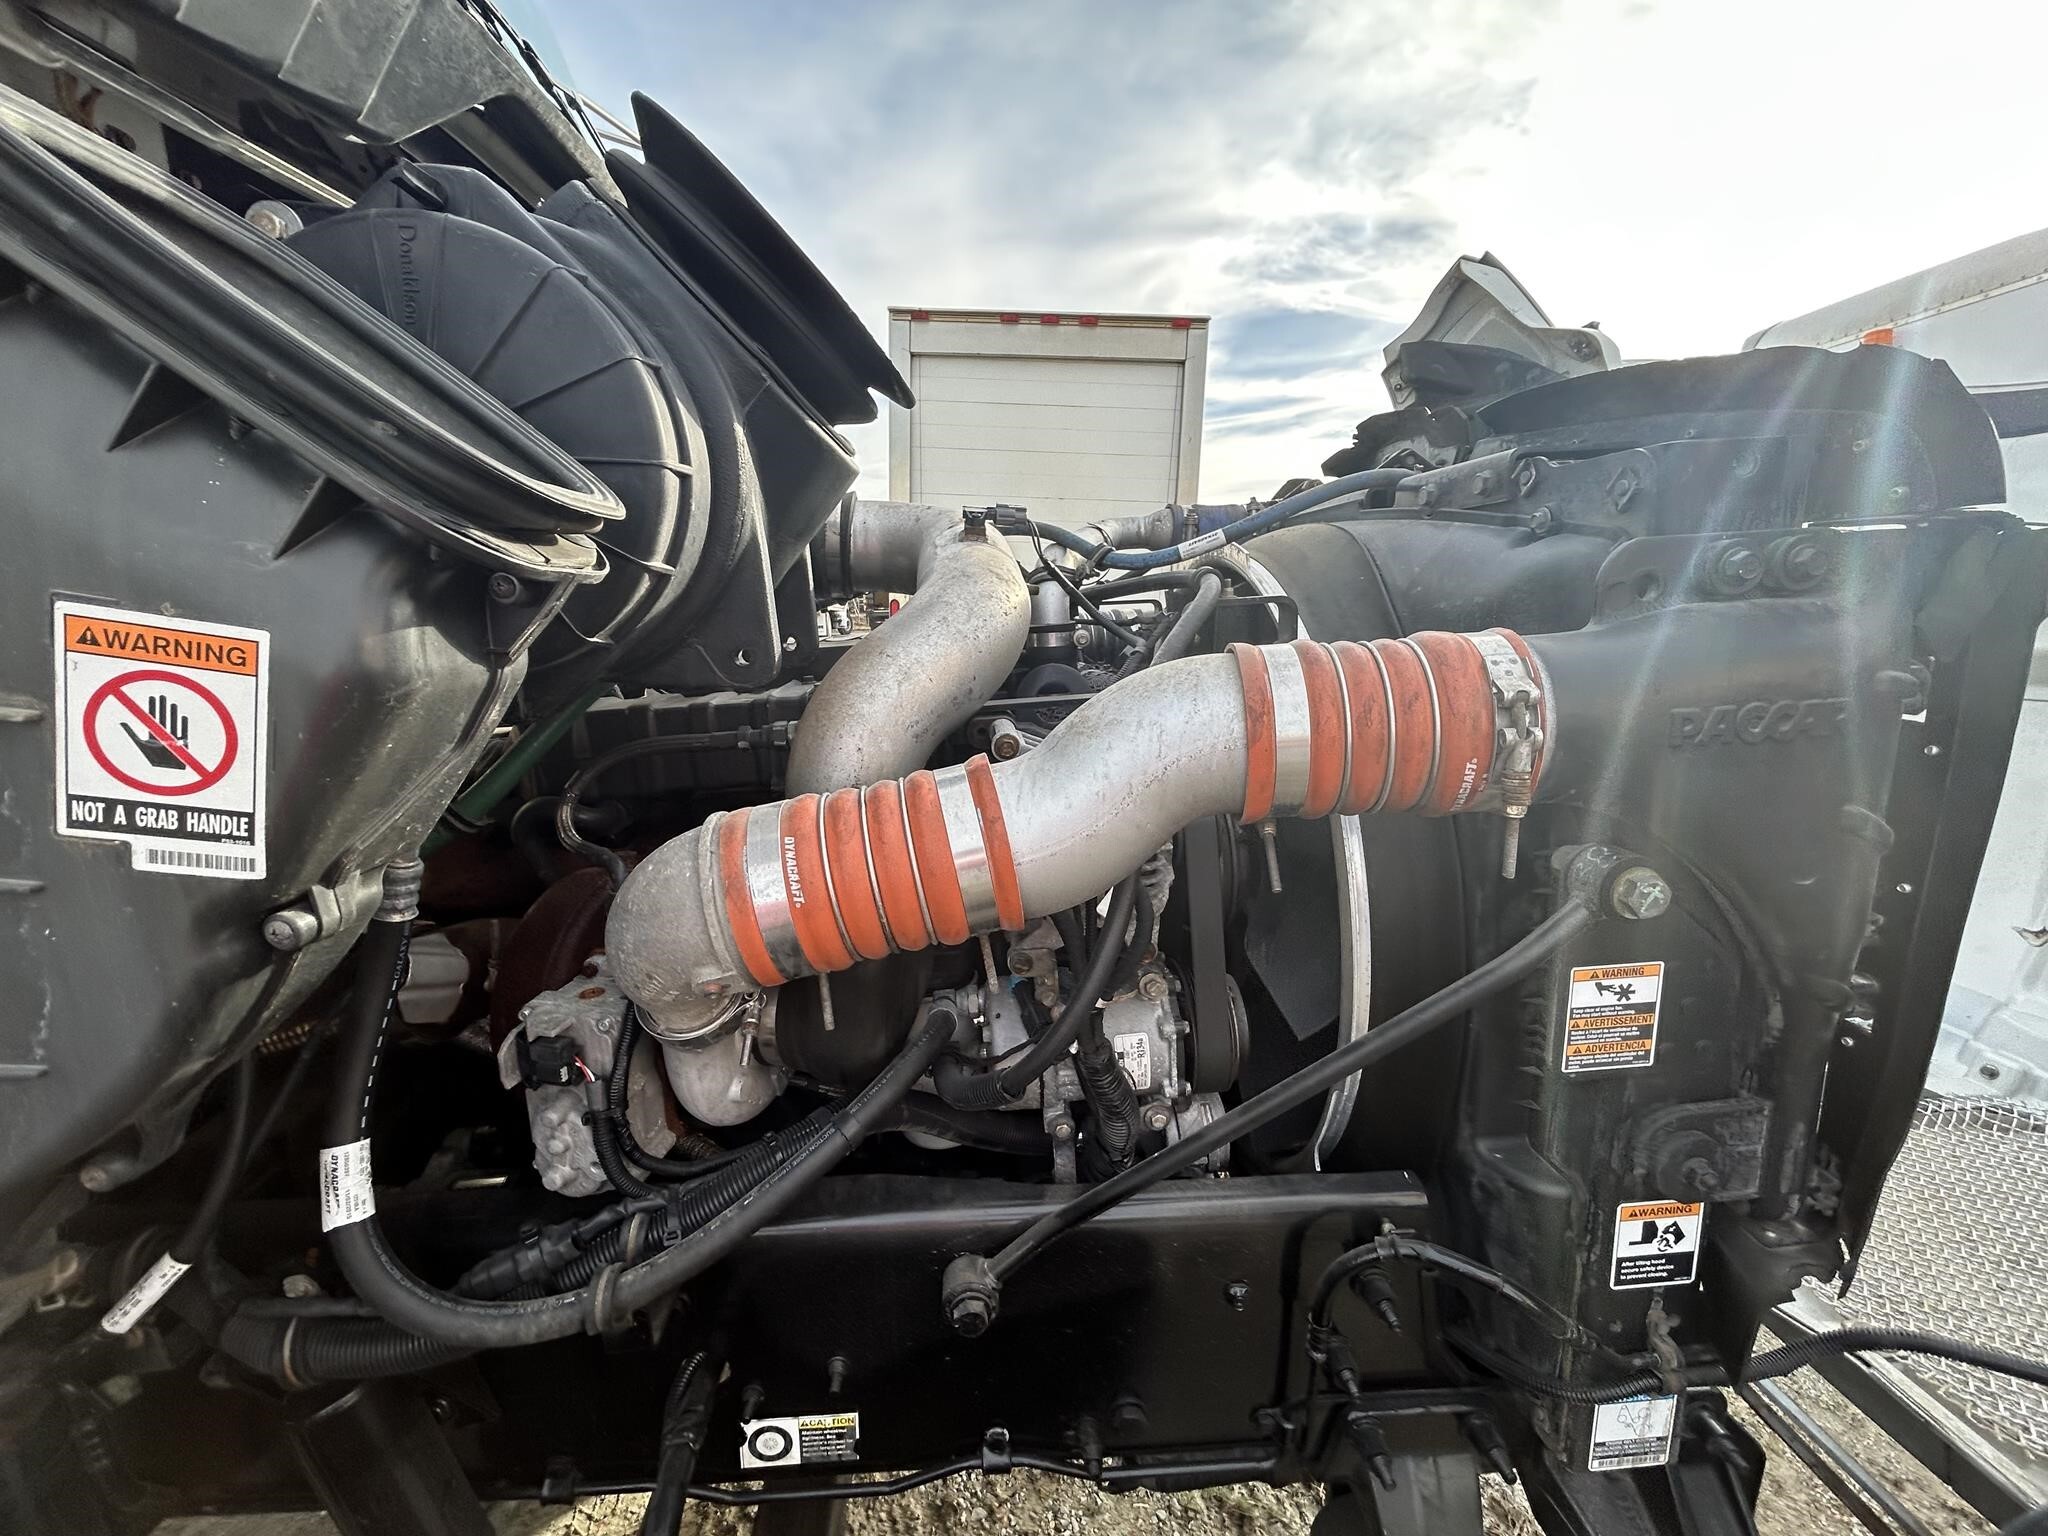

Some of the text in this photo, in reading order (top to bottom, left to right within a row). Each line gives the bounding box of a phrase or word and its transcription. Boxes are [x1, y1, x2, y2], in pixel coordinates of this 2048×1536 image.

[398, 224, 420, 325] Donaldson
[102, 627, 248, 668] WARNING
[1450, 762, 1478, 811] NACRAFT
[71, 799, 249, 837] NOT A GRAB HANDLE
[784, 836, 805, 904] DYNACRAFT
[1601, 967, 1645, 979] WARNING
[1583, 1015, 1654, 1028] AVERTISSEMENT
[1584, 1041, 1646, 1053] ADVERTENCIA
[1638, 1205, 1693, 1217] WARNING
